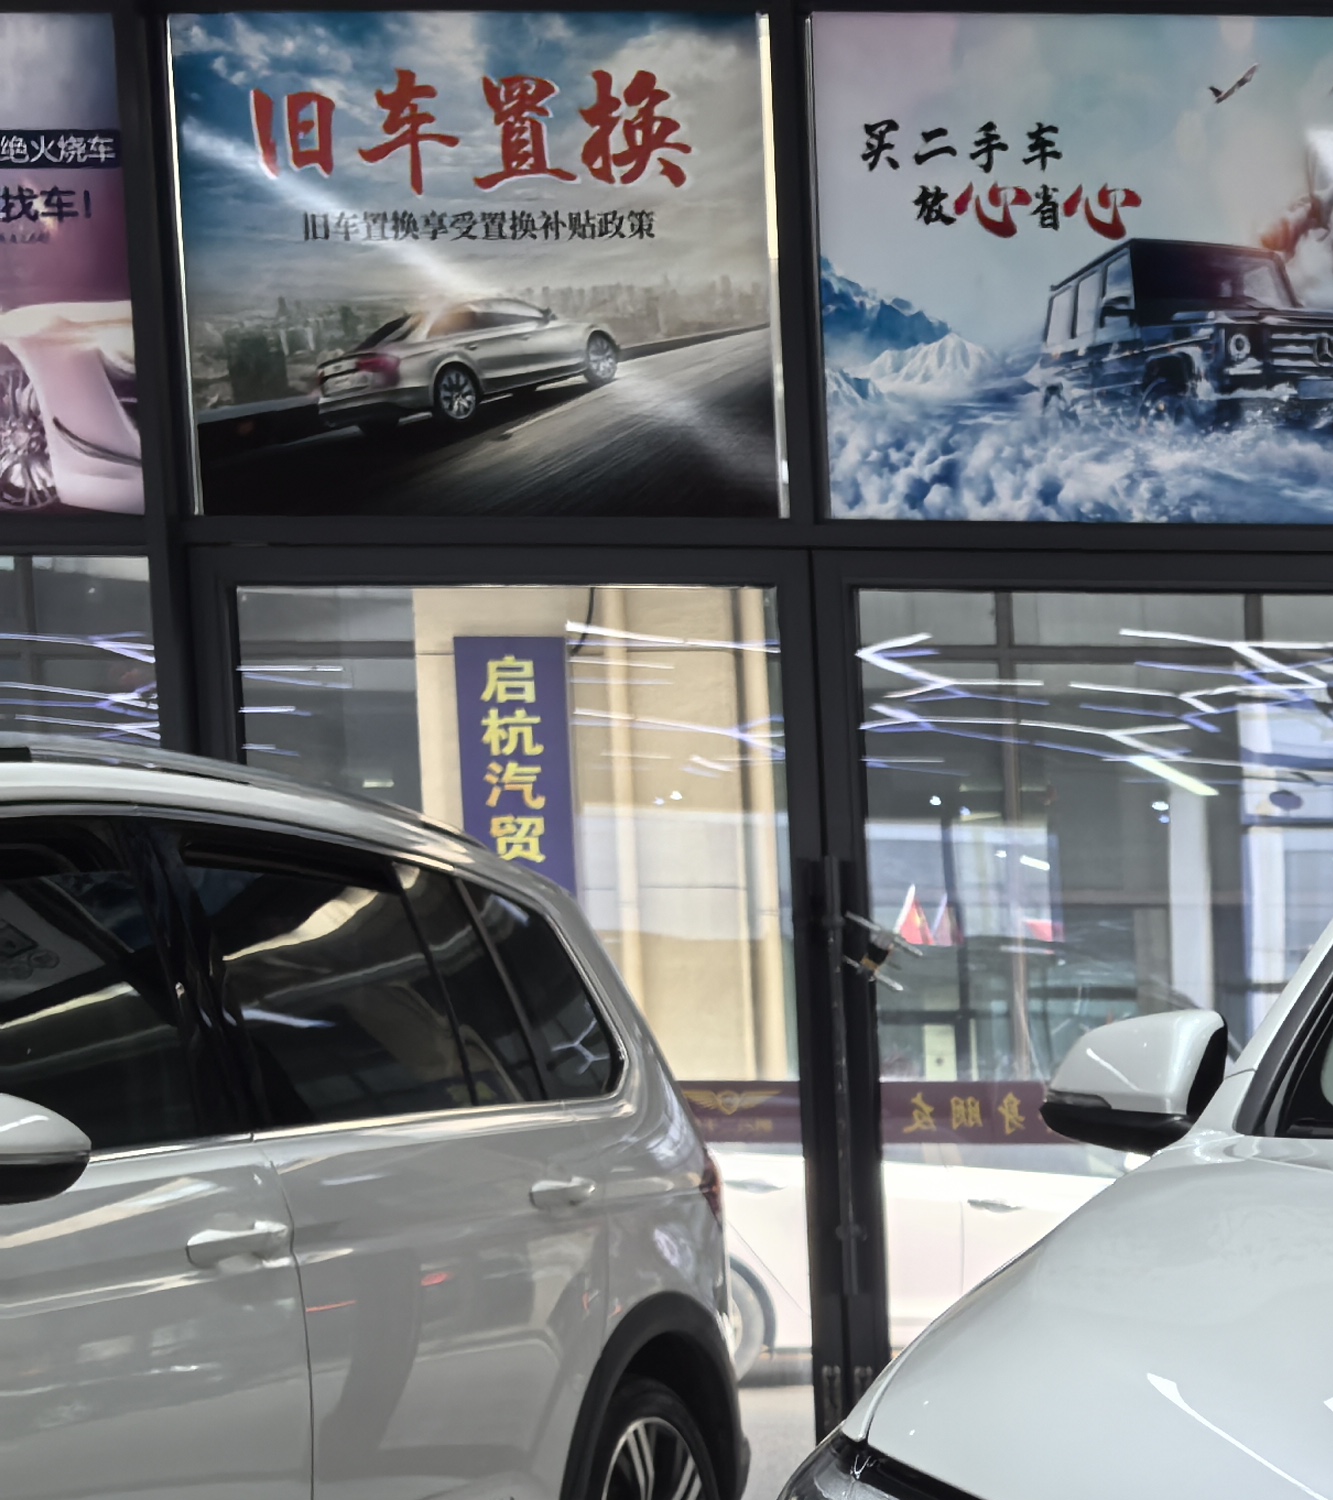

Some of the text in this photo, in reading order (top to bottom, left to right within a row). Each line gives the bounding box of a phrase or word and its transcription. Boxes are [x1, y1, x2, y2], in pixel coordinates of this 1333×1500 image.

[249, 68, 693, 197] 旧车置换
[860, 118, 1063, 172] 买二手车
[302, 208, 656, 242] 旧车置换享受置换补贴政策
[913, 181, 1142, 240] 放心省心
[479, 654, 546, 863] 启杭汽贸
